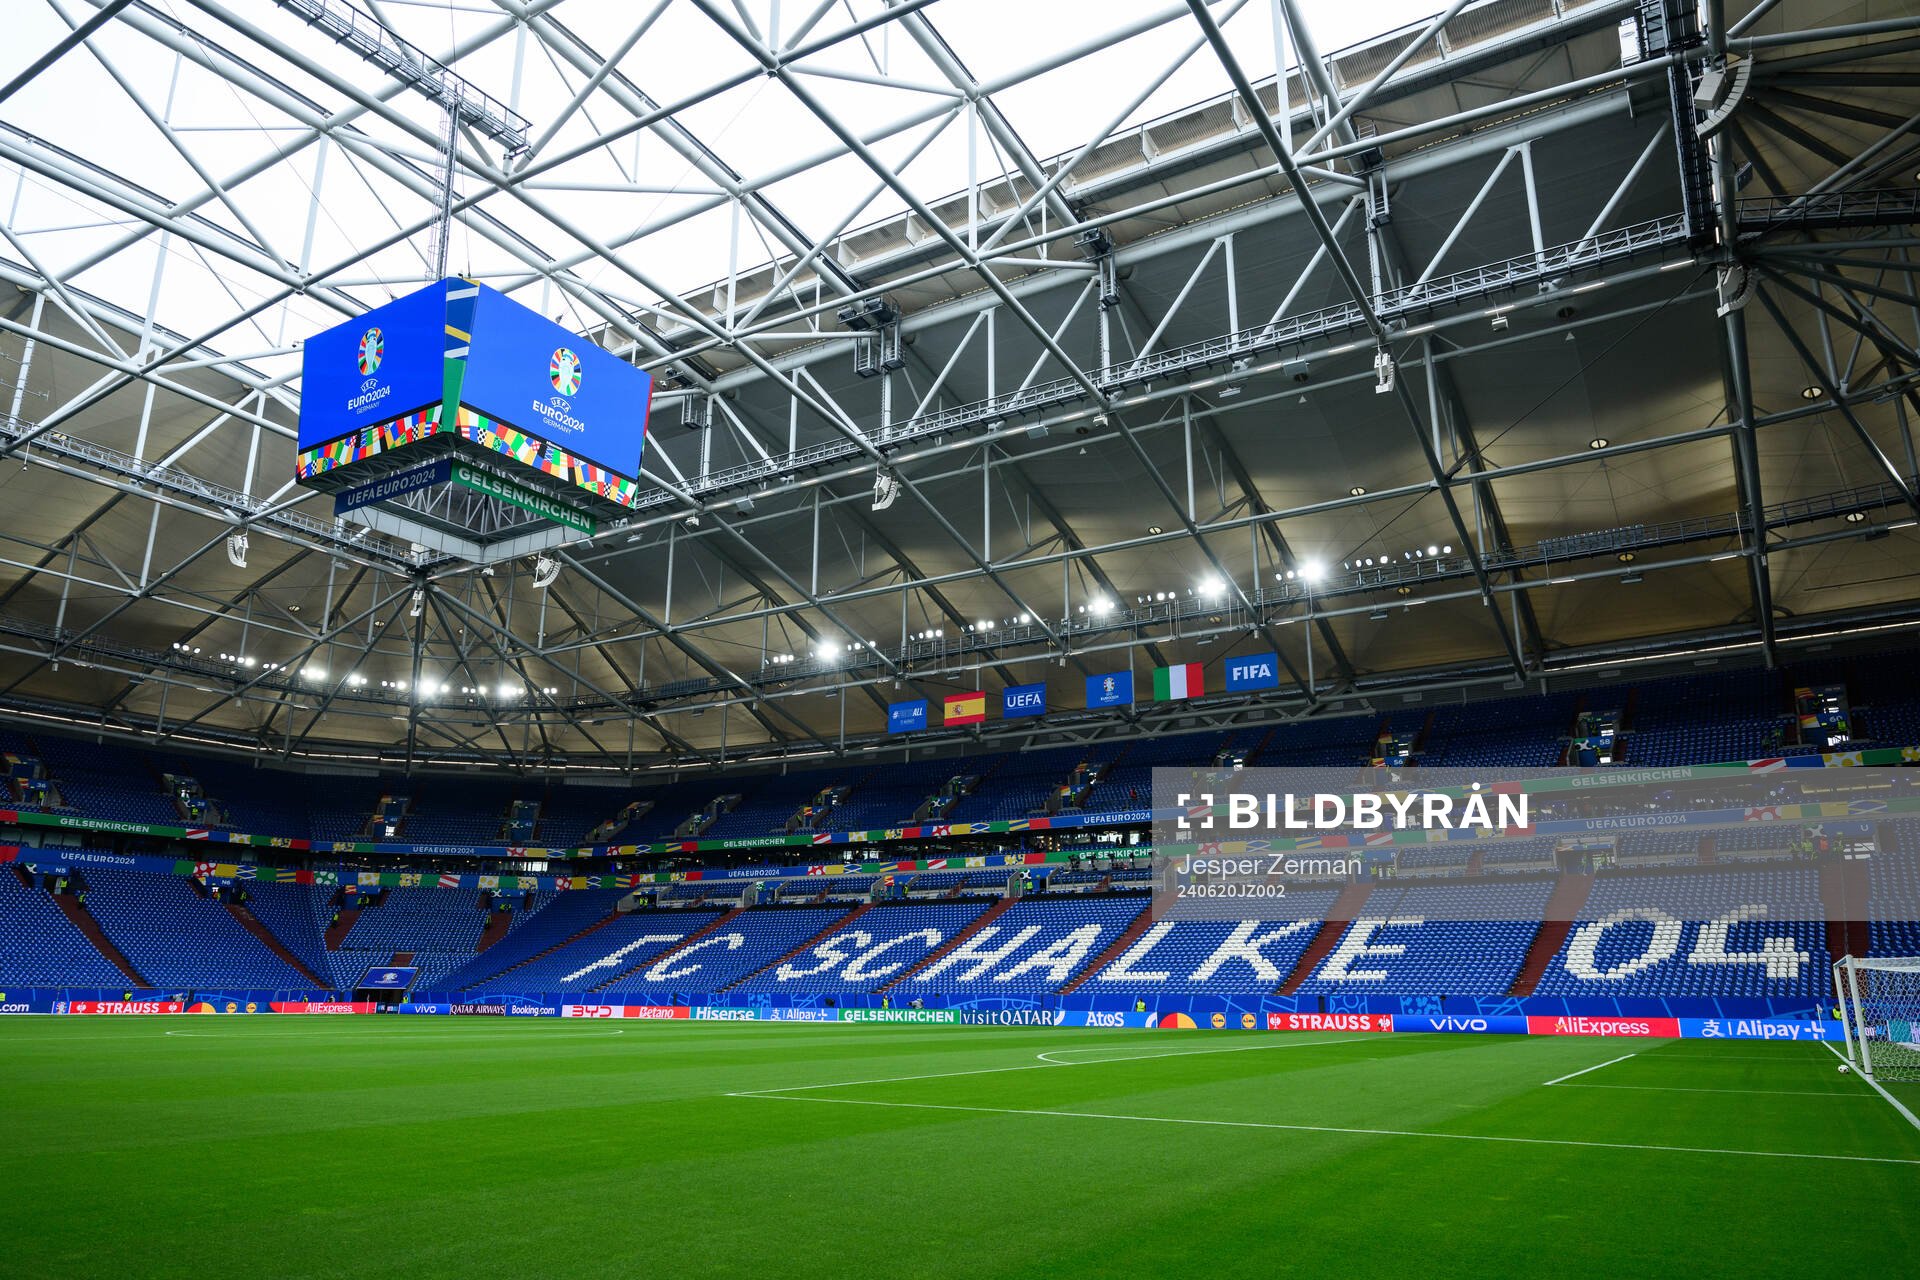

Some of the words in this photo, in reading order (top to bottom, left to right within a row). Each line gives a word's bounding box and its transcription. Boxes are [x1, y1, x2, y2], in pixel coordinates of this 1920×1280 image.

[361, 380, 378, 392] UEFA
[356, 401, 380, 415] GERMANY
[551, 398, 570, 413] UEFA
[543, 417, 572, 435] GERMANY
[458, 467, 591, 530] GELSENKIRCHEN
[1232, 663, 1272, 681] FIFA
[1006, 693, 1041, 708] UEFA
[1571, 769, 1692, 788] GELSENKIRCHEN
[60, 817, 150, 833] GELSENKIRCHEN
[723, 838, 786, 848] GELSENKIRCHEN
[561, 933, 744, 982] FC
[776, 918, 1427, 983] SCHALKE
[1564, 904, 1811, 983] 04
[96, 1002, 160, 1014] STRAUSS
[305, 1002, 353, 1013] AliExpress
[451, 1004, 474, 1014] QATAR
[475, 1005, 505, 1014] AIRWAYS
[512, 1004, 555, 1016] Booking.com
[640, 1007, 674, 1018] Betano
[696, 1006, 755, 1020] Hisense
[844, 1010, 955, 1022] GELSENKIRCHEN
[1289, 1015, 1370, 1030] STRAUSS
[1555, 1018, 1650, 1036] AliExpress
